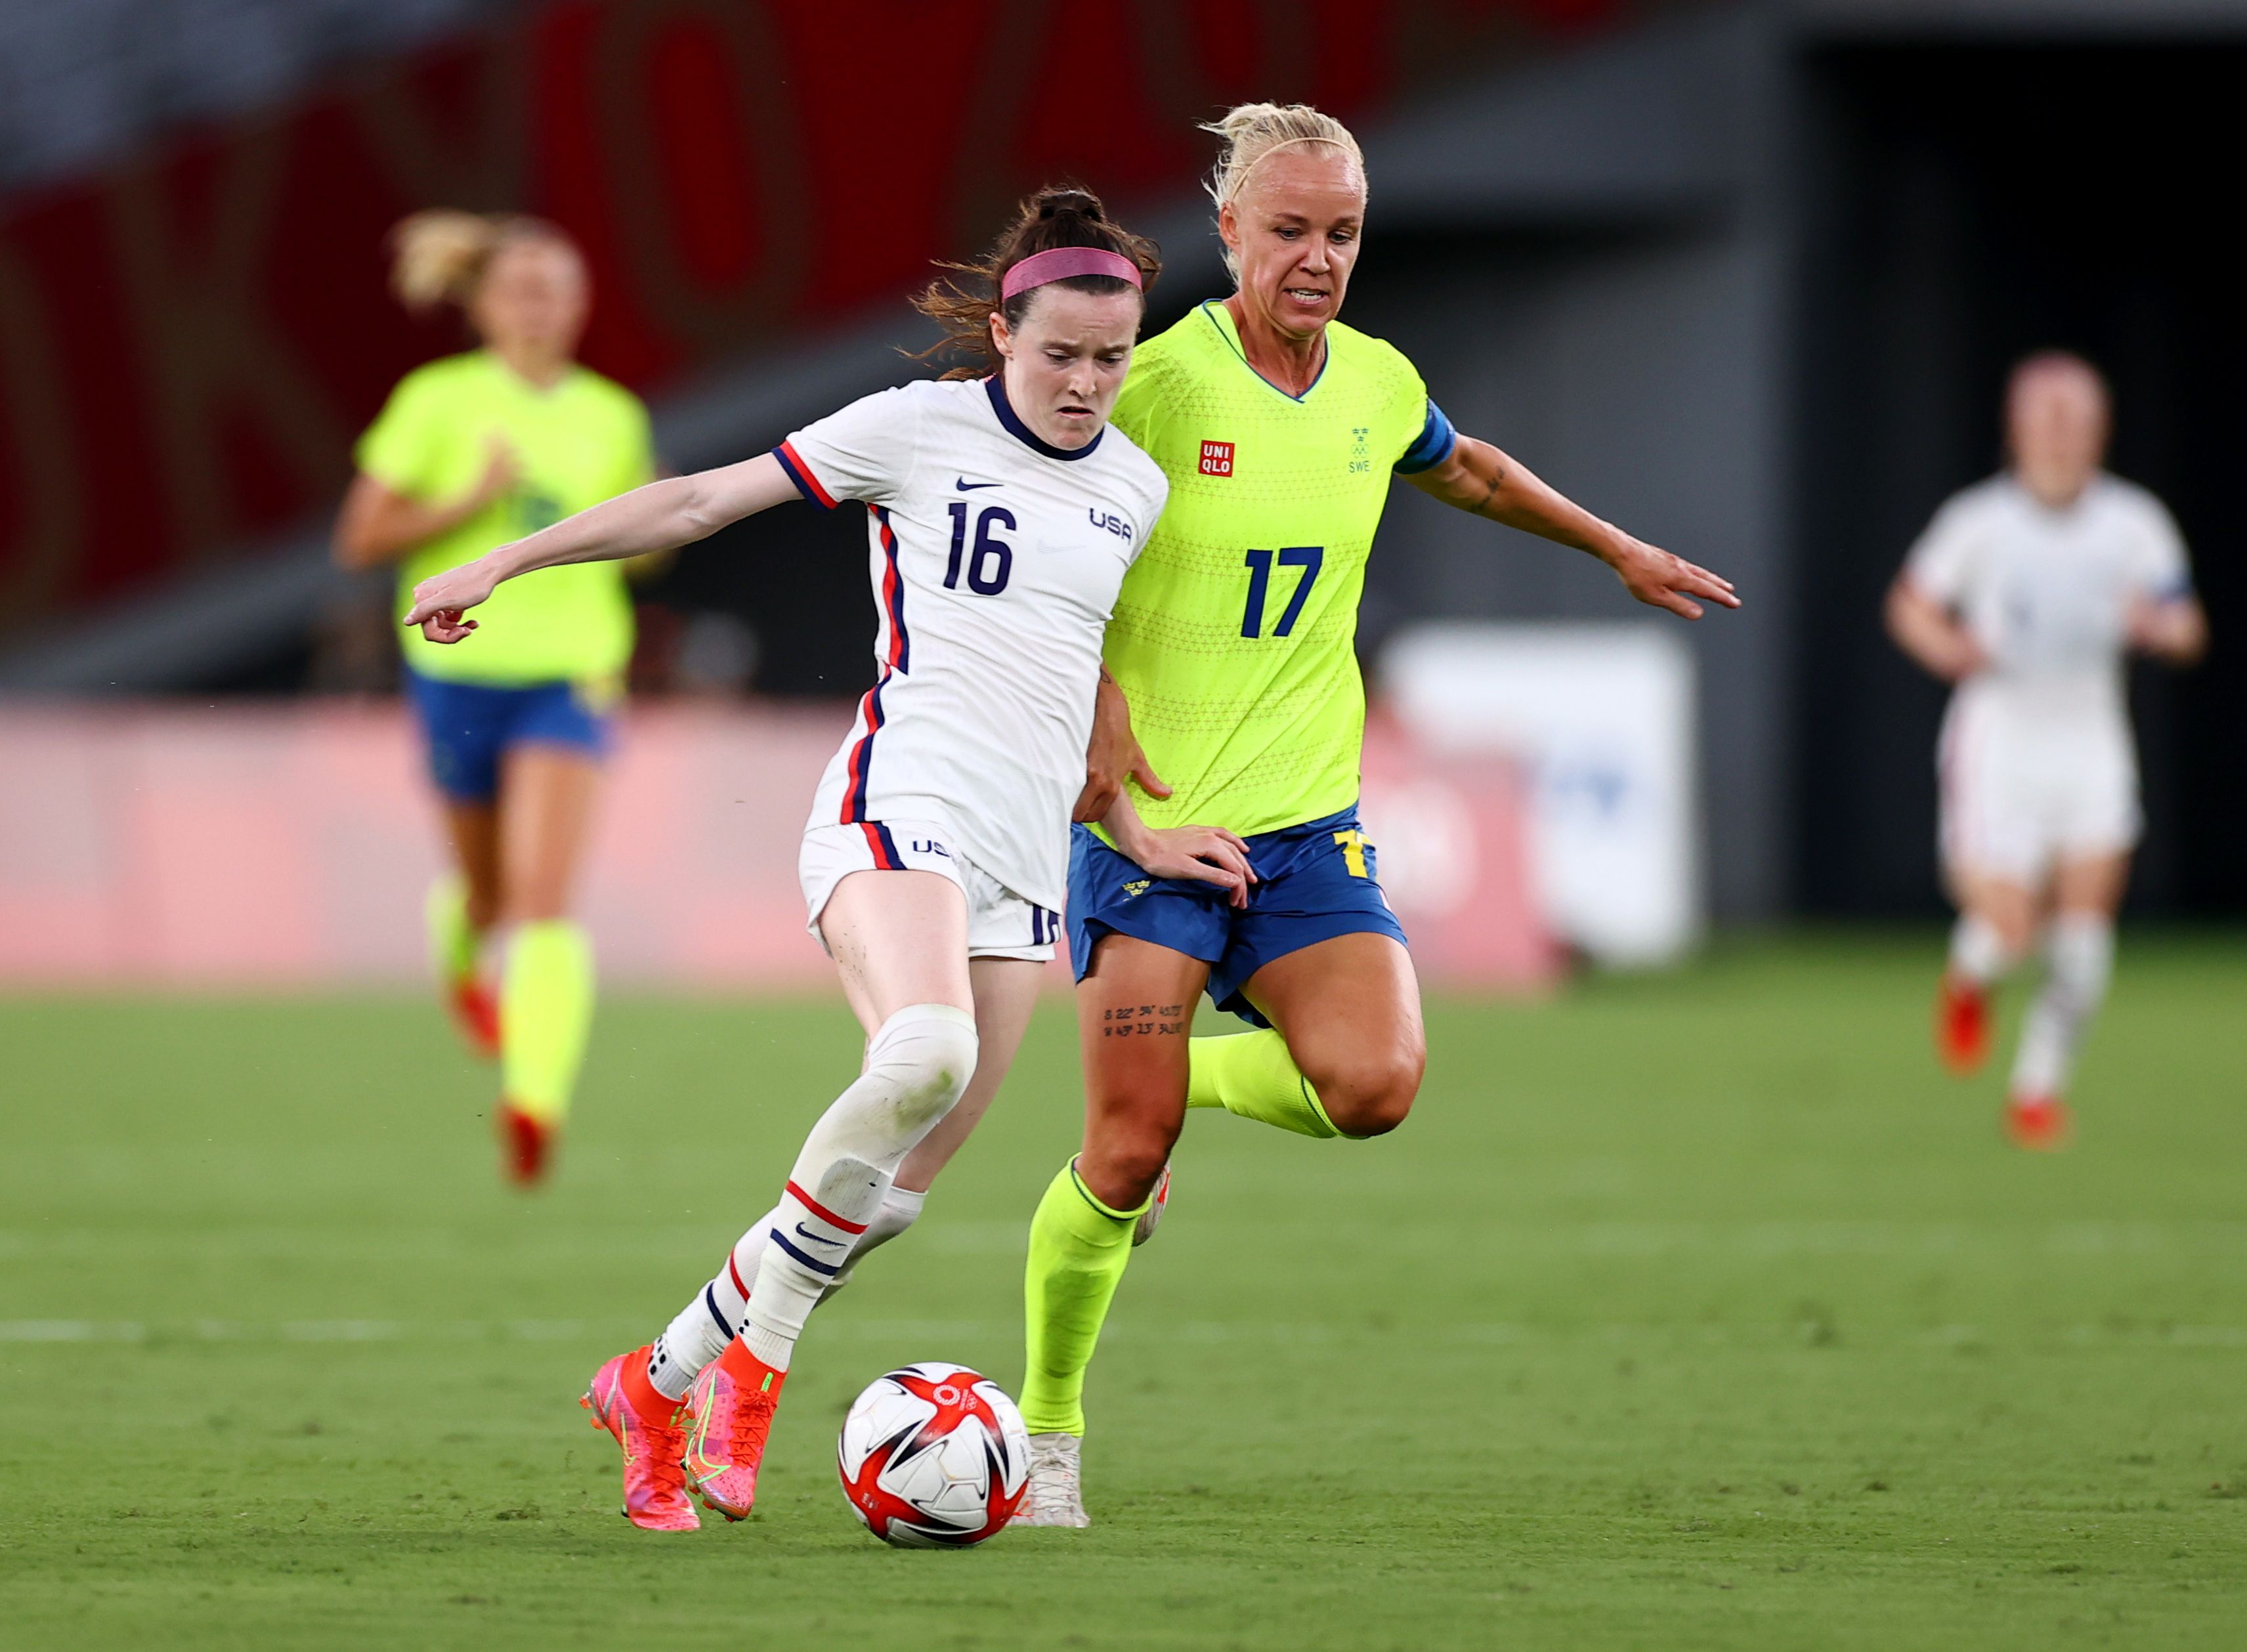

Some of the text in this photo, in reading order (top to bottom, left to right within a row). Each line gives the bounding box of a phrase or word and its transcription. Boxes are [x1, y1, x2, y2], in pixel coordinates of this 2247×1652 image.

[1203, 444, 1230, 459] UNI
[1202, 458, 1230, 473] QLO
[1349, 461, 1370, 473] SWE
[1090, 507, 1132, 545] USA
[943, 502, 1017, 595] 16
[1241, 546, 1324, 639] 17
[912, 839, 951, 857] US
